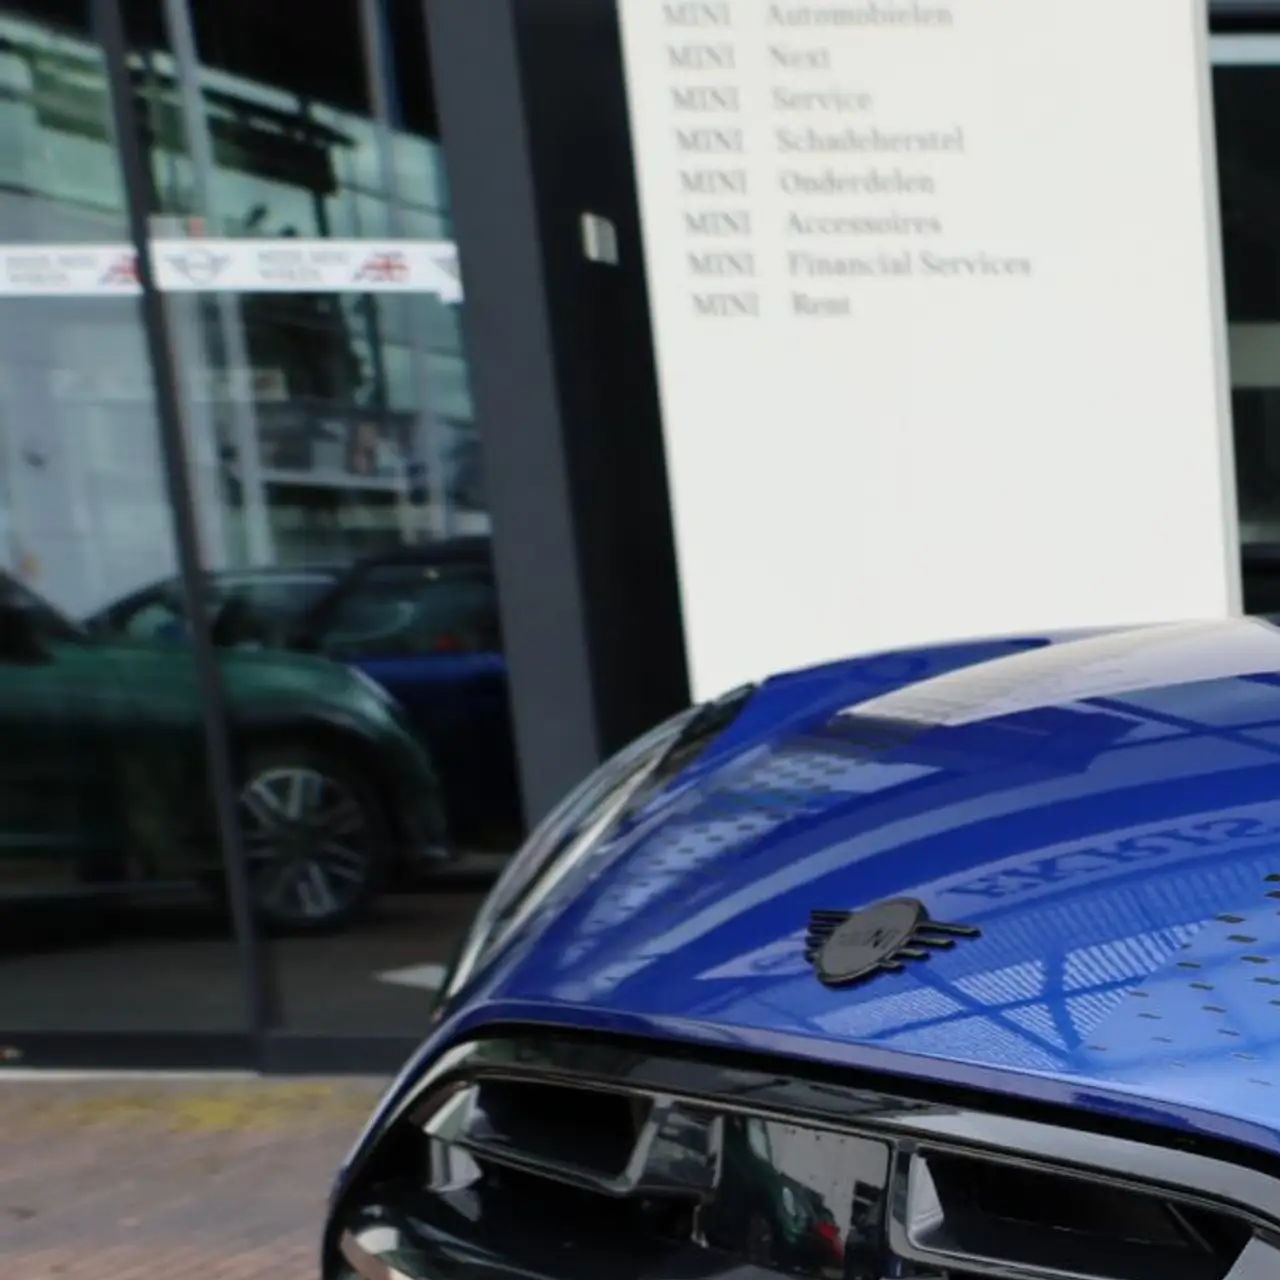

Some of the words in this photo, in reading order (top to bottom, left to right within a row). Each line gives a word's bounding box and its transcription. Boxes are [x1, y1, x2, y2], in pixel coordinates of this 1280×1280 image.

[661, 3, 731, 26] MINI
[667, 45, 736, 70] MINI
[768, 44, 830, 69] Next
[671, 86, 740, 111] MINI
[771, 86, 873, 110] Service
[676, 127, 744, 153] MINI
[775, 125, 965, 153] Schadeherstel
[679, 169, 748, 195] MINI
[778, 168, 936, 195] Onderdelen
[683, 210, 751, 236] MINI
[787, 210, 943, 236] Accessoires
[687, 251, 755, 277] MINI
[787, 250, 912, 277] Financial
[919, 250, 1033, 277] Services
[692, 292, 760, 318] MINI
[790, 291, 852, 317] Rent
